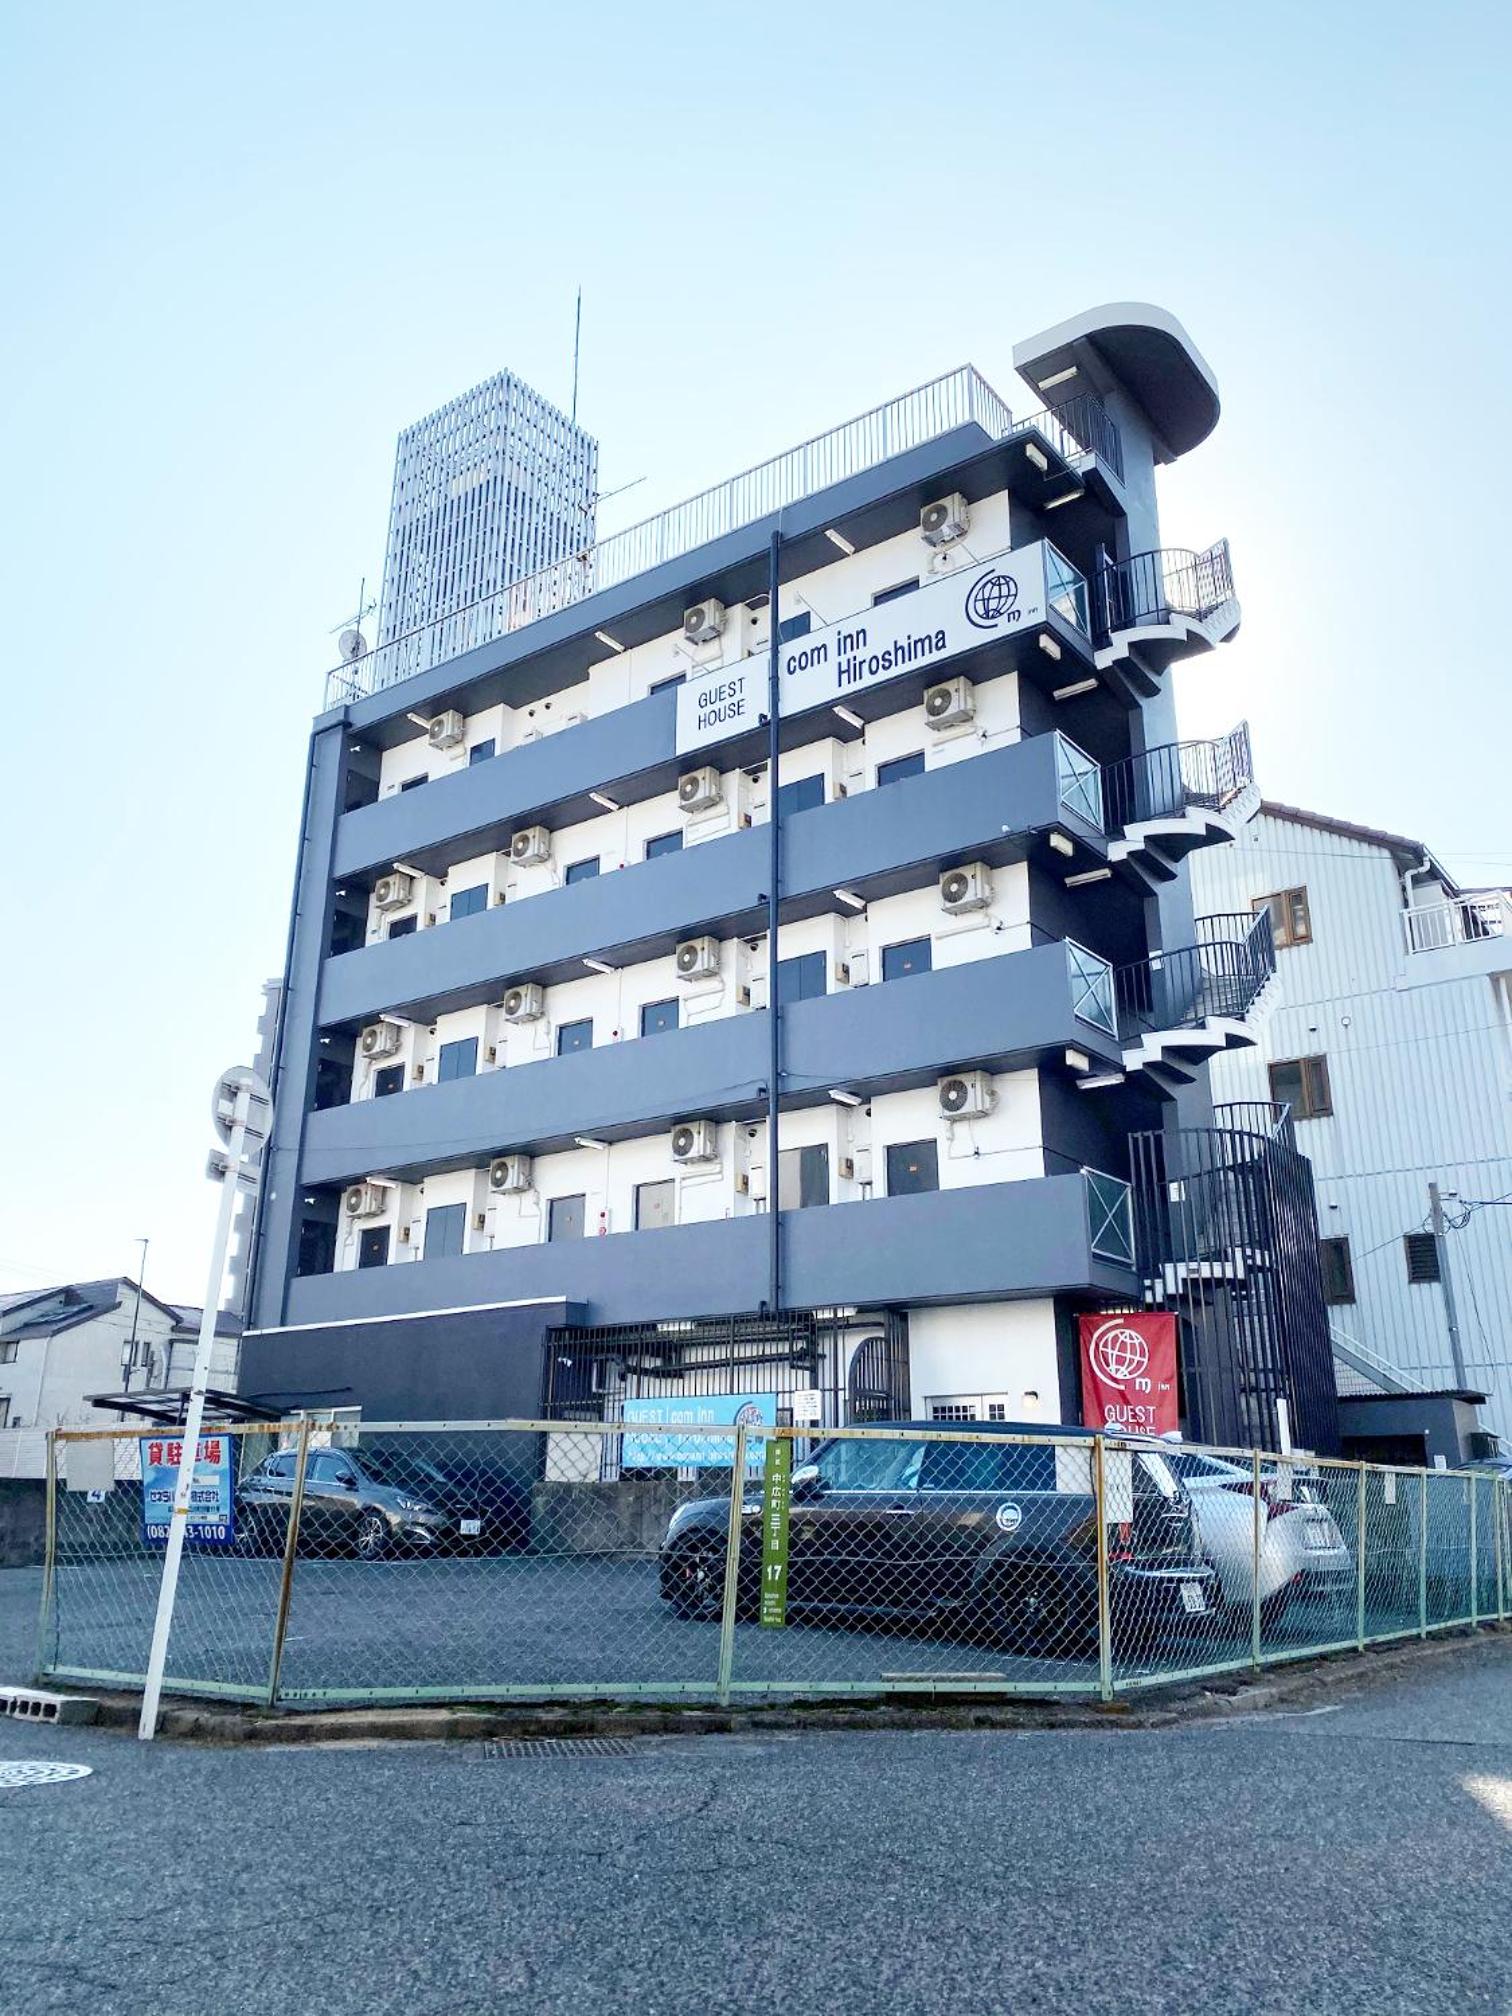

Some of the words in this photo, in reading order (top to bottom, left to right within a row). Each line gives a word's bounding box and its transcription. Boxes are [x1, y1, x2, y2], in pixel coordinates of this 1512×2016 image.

[786, 642, 828, 675] com
[836, 627, 868, 657] inn
[836, 629, 947, 688] Hiroshima
[698, 677, 745, 709] GUEST
[698, 698, 745, 731] HOUSE
[1104, 1404, 1157, 1424] GUEST
[766, 1564, 782, 1581] 17
